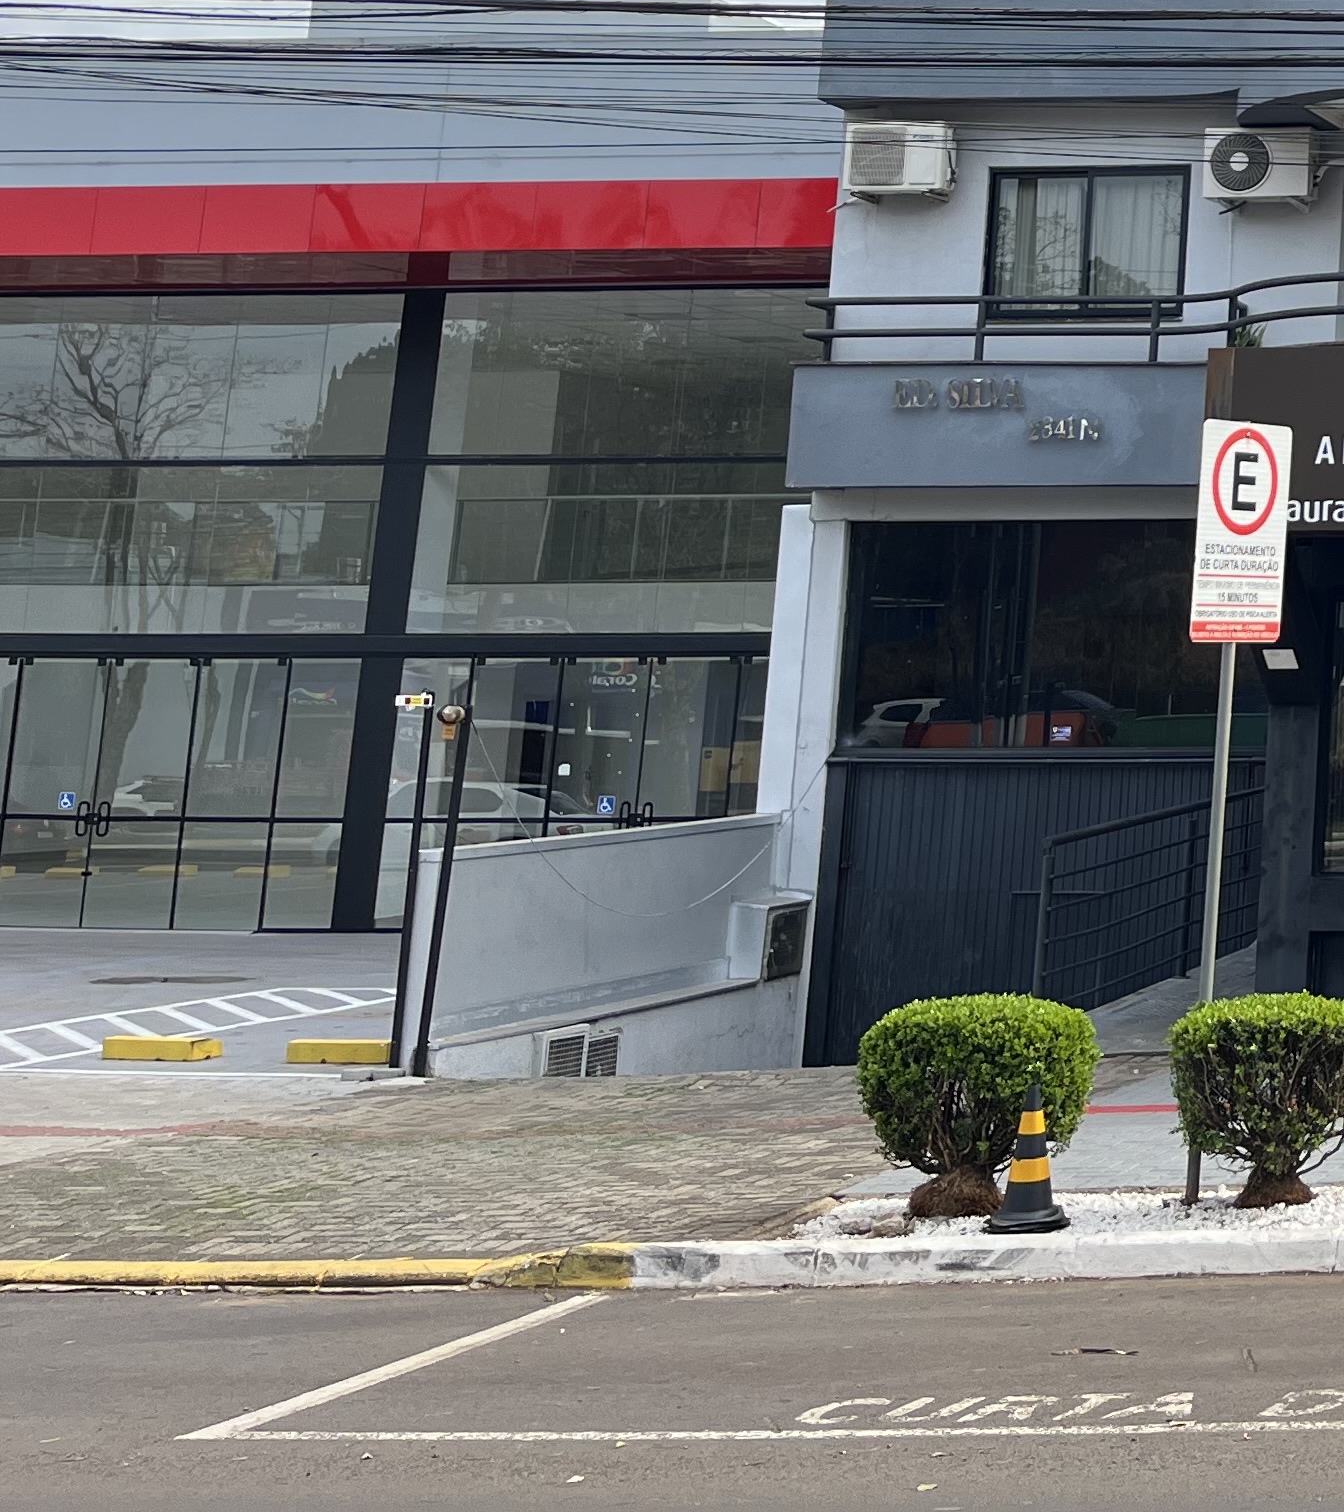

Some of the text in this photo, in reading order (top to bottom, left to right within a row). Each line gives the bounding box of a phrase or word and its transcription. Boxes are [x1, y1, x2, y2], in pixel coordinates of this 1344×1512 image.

[947, 378, 1026, 409] SILVA
[1315, 436, 1335, 465] A
[1231, 451, 1259, 512] E
[1205, 543, 1276, 557] ESTACIONAMENTO
[1200, 558, 1279, 573] DE CURTA DURAÇÃO
[1217, 592, 1259, 603] 15 MINUTOS
[795, 1391, 1195, 1424] CURTA
